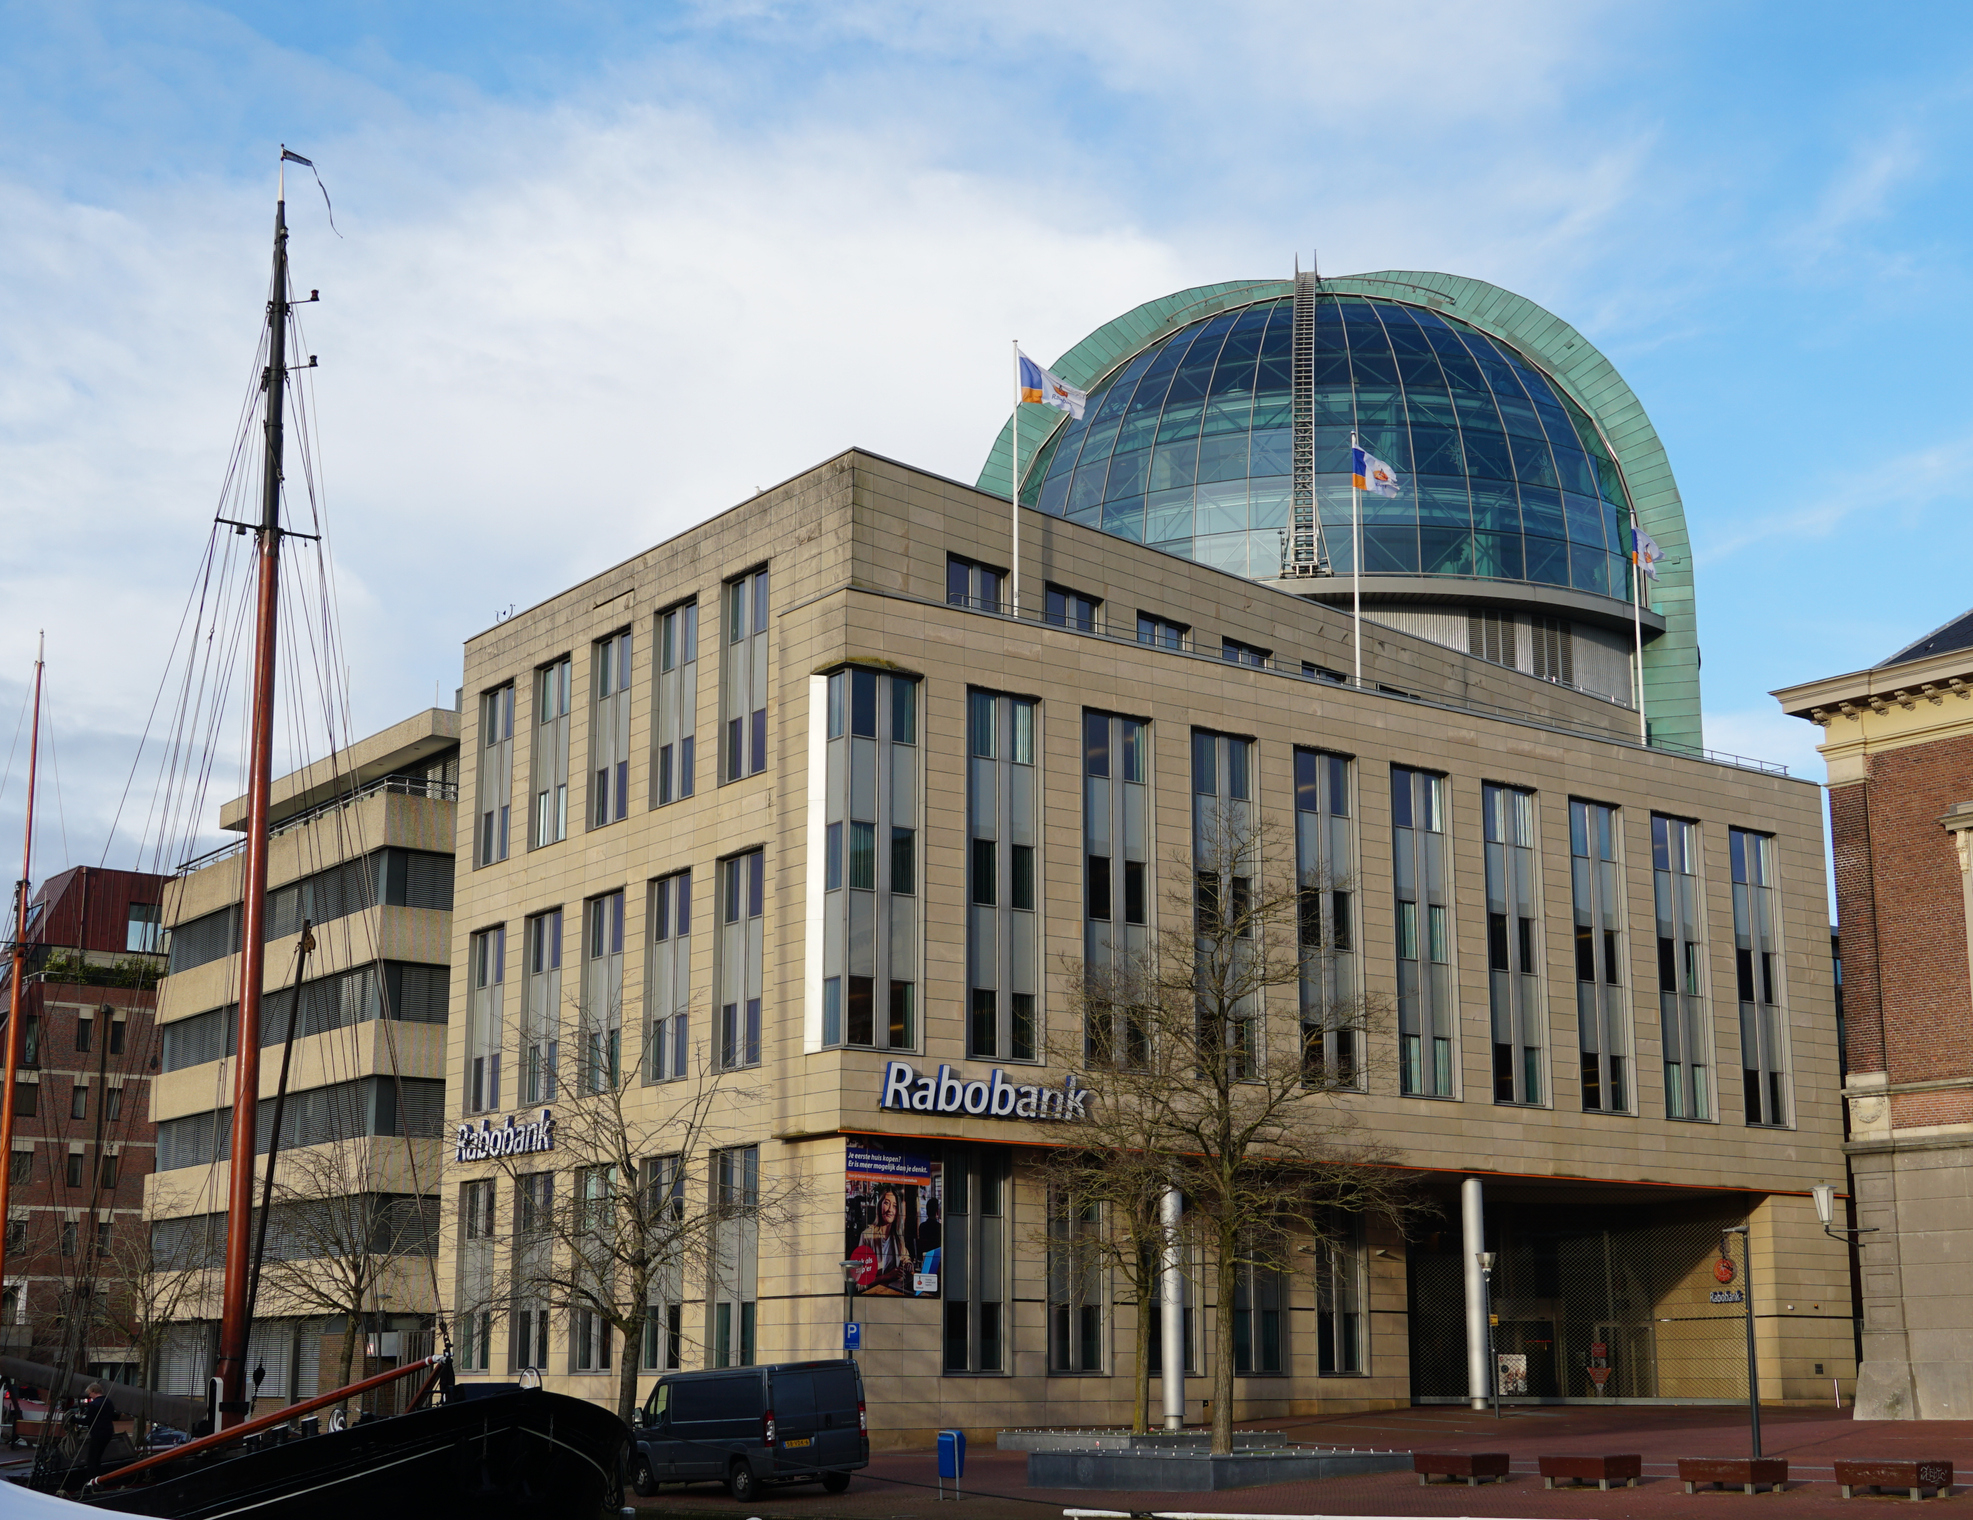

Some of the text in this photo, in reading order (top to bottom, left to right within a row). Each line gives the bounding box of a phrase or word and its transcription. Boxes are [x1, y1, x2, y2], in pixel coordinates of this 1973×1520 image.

[881, 1061, 1089, 1121] Rabobank
[455, 1109, 556, 1163] Rabobank
[882, 1155, 902, 1163] kopen?
[854, 1160, 859, 1168] is
[873, 1163, 895, 1172] mogelijk
[896, 1164, 906, 1172] dan
[905, 1165, 912, 1174] je
[911, 1165, 928, 1173] denkt.
[847, 1324, 857, 1339] P
